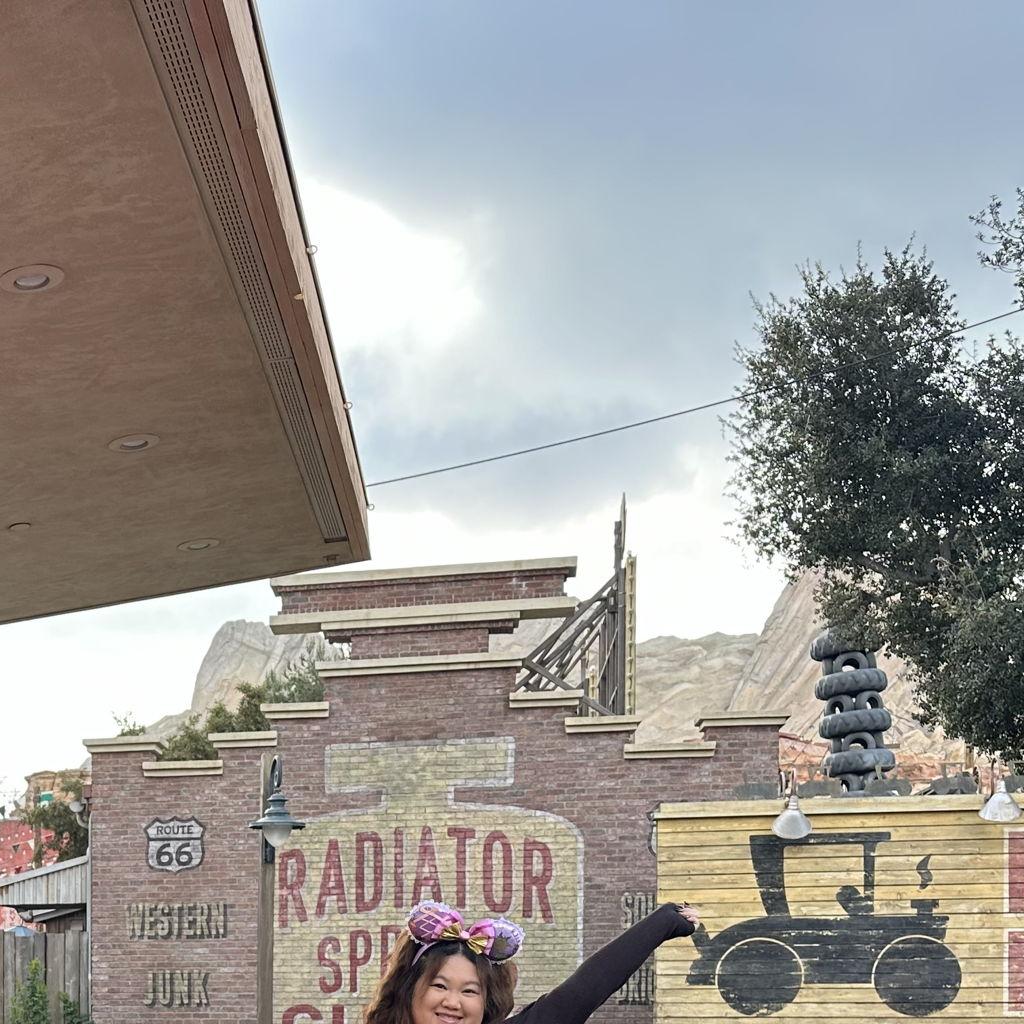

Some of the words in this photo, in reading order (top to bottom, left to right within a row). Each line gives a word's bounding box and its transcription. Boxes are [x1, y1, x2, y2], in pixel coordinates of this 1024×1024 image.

[156, 825, 194, 835] ROUTE
[155, 842, 193, 866] 66
[278, 825, 555, 928] RADIATOR
[126, 902, 227, 939] WESTERN
[143, 969, 210, 1008] JUNK
